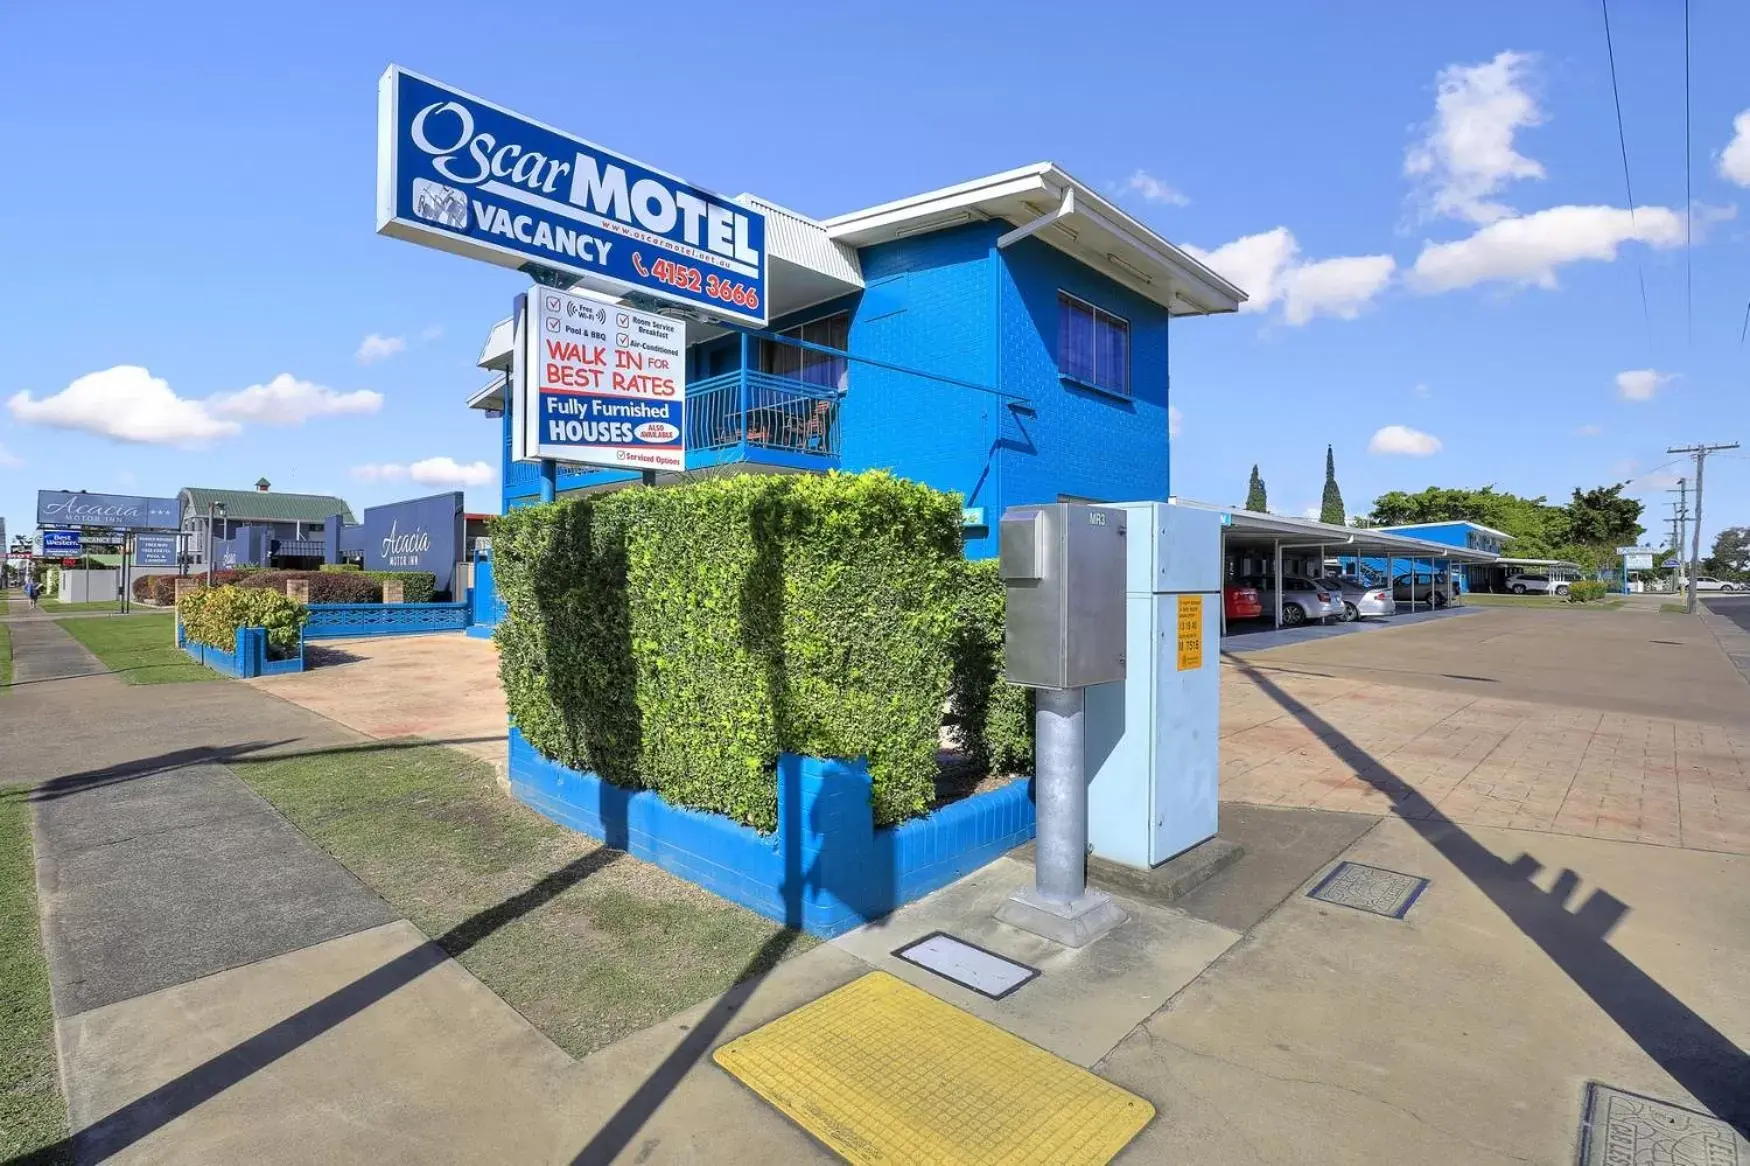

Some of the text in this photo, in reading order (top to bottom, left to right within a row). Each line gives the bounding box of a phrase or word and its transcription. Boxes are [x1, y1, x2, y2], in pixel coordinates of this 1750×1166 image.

[411, 100, 760, 267] Oscar MOTEL
[472, 199, 612, 267] VACANCY
[601, 219, 731, 269] www.oscarmotel.net.au
[651, 256, 760, 310] 4152 3666
[579, 304, 593, 313] Free
[565, 325, 607, 341] Pool & BBQ
[632, 316, 675, 333] Room Service
[638, 326, 669, 340] Breakfast
[546, 339, 669, 371] WALK IN FOR
[630, 340, 679, 356] Air-Conditioned
[546, 364, 676, 397] BEST RATES
[546, 397, 670, 418] Fully Furnished
[548, 420, 634, 443] HOUSES
[656, 456, 680, 466] Options
[43, 496, 140, 517] Acacia
[65, 514, 101, 522] MOTOR
[380, 519, 432, 558] Acacia
[389, 556, 407, 566] MOTOR
